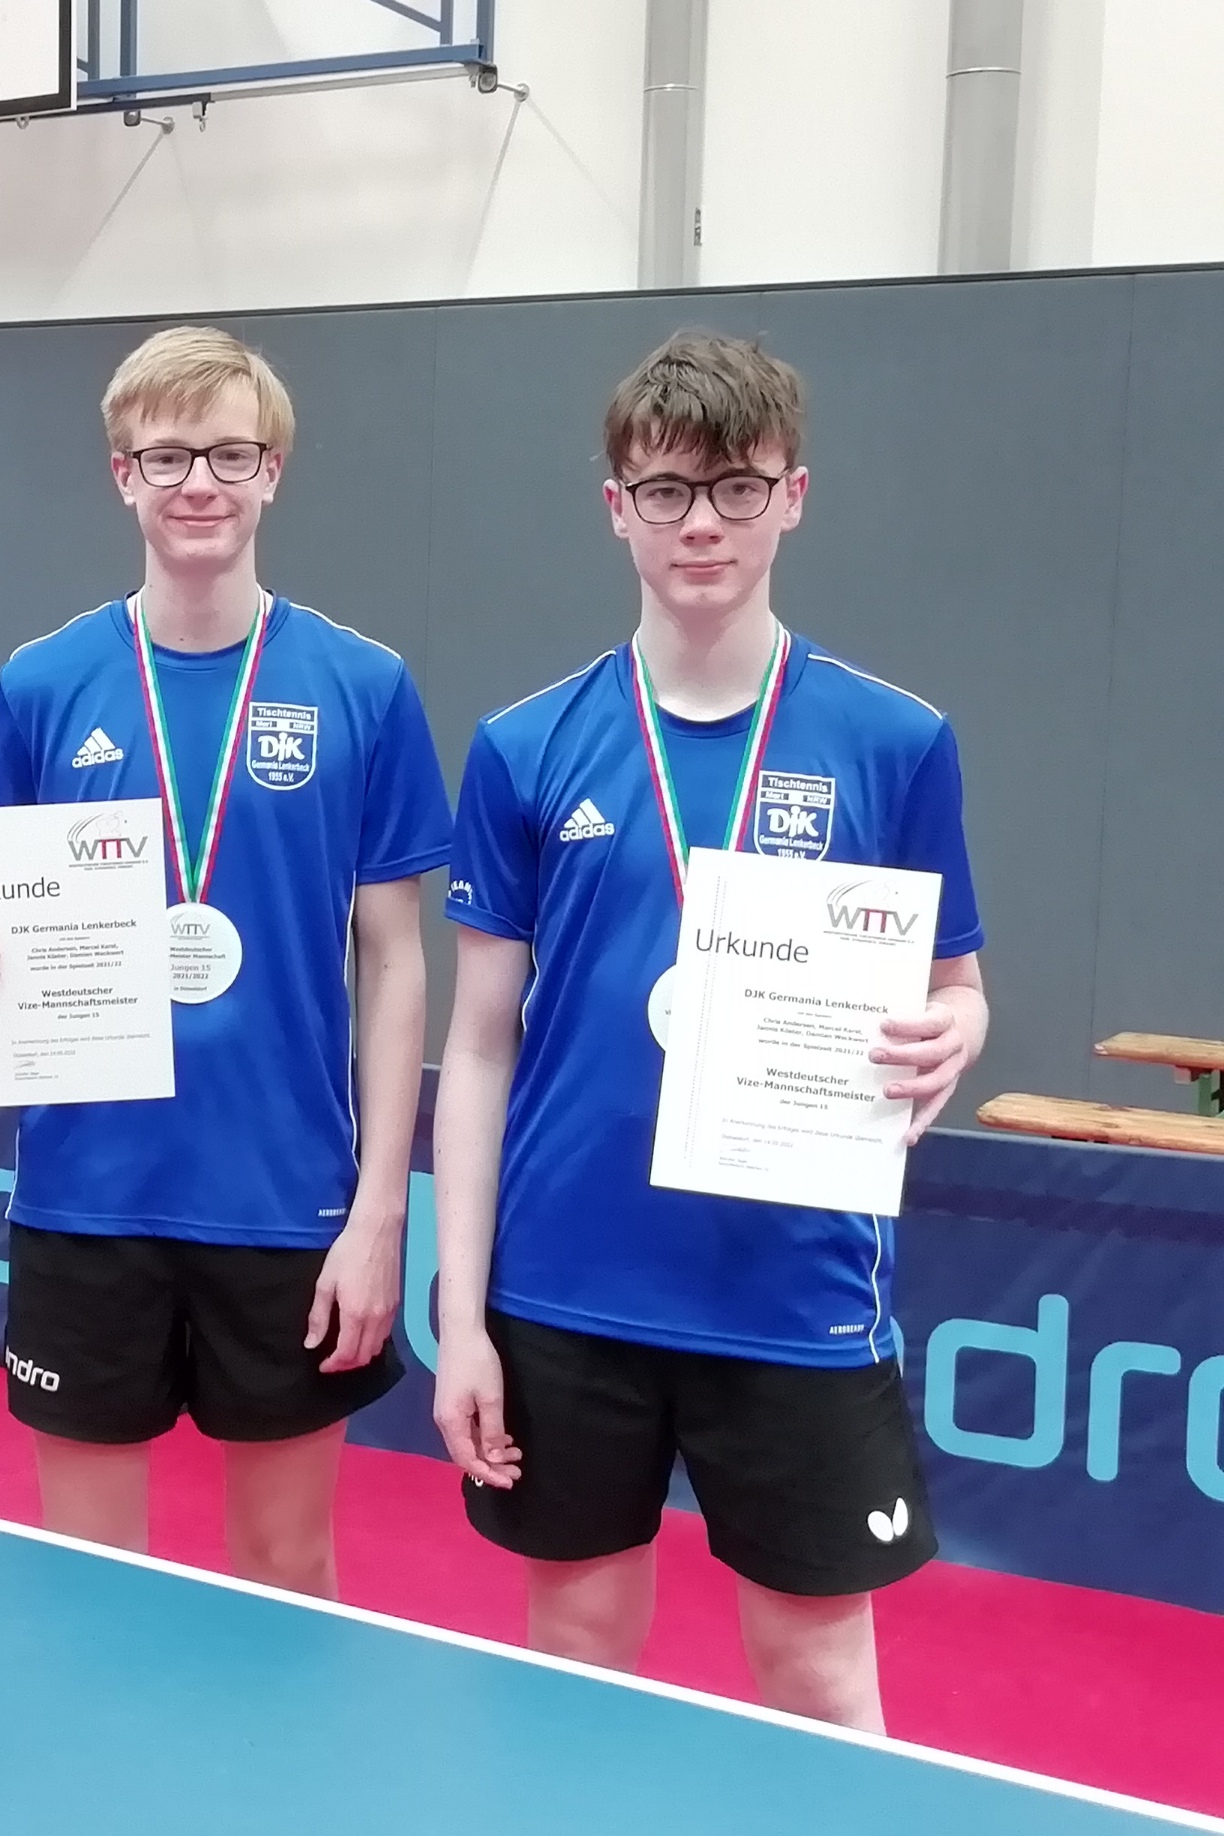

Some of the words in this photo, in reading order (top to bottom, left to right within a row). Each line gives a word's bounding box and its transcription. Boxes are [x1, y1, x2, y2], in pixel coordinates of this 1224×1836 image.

[257, 708, 311, 720] Tischtennis
[72, 748, 124, 768] adidas
[768, 777, 828, 792] Tischtennis
[559, 822, 615, 842] adidas
[68, 836, 148, 861] WTTV
[11, 925, 29, 934] DJK
[32, 922, 78, 932] Germania
[81, 918, 136, 929] Lenkerbeck
[170, 924, 210, 935] WTTV
[827, 903, 919, 936] WTTV
[695, 928, 809, 964] Urkunde
[41, 986, 113, 998] Westdeutscher
[744, 988, 765, 999] DJK
[768, 991, 821, 1005] Germania
[825, 998, 889, 1013] Lenkerbeck
[17, 995, 138, 1010] Vize-Mannschaftsmeister
[765, 1067, 849, 1086] Westdeutscher
[735, 1076, 876, 1102] Vize-Mannschaftsmeister
[5, 1345, 60, 1392] ndro
